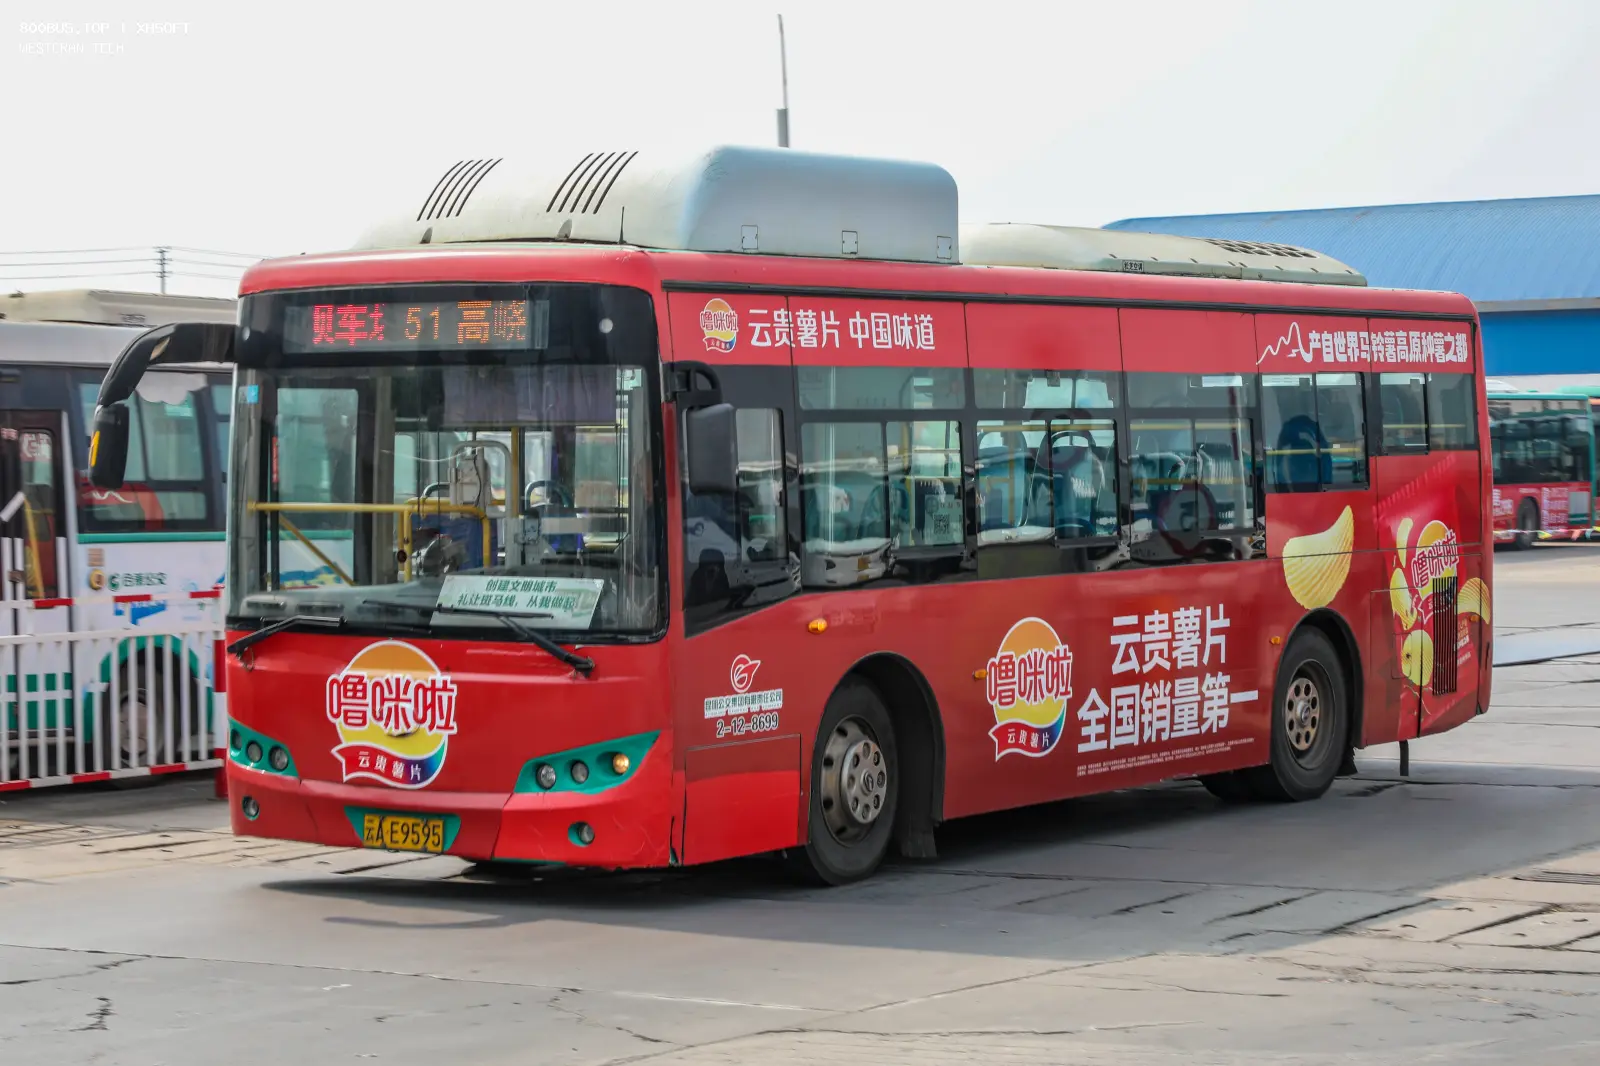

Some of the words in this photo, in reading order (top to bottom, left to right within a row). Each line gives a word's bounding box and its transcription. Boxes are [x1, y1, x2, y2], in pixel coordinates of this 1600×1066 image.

[404, 306, 440, 340] 51
[748, 308, 841, 348] 云贵薯片
[849, 311, 936, 350] 中国味道
[485, 579, 558, 593] 创建文明城市
[1110, 603, 1231, 675] 云贵薯片
[987, 644, 1073, 710] 噜咪啦
[326, 672, 458, 736] 噜咪啦
[1076, 671, 1259, 754] 全国销量第一
[716, 711, 779, 738] 2-12-8699
[1007, 728, 1051, 748] 云贵薯片
[358, 751, 422, 781] 云贵薯片
